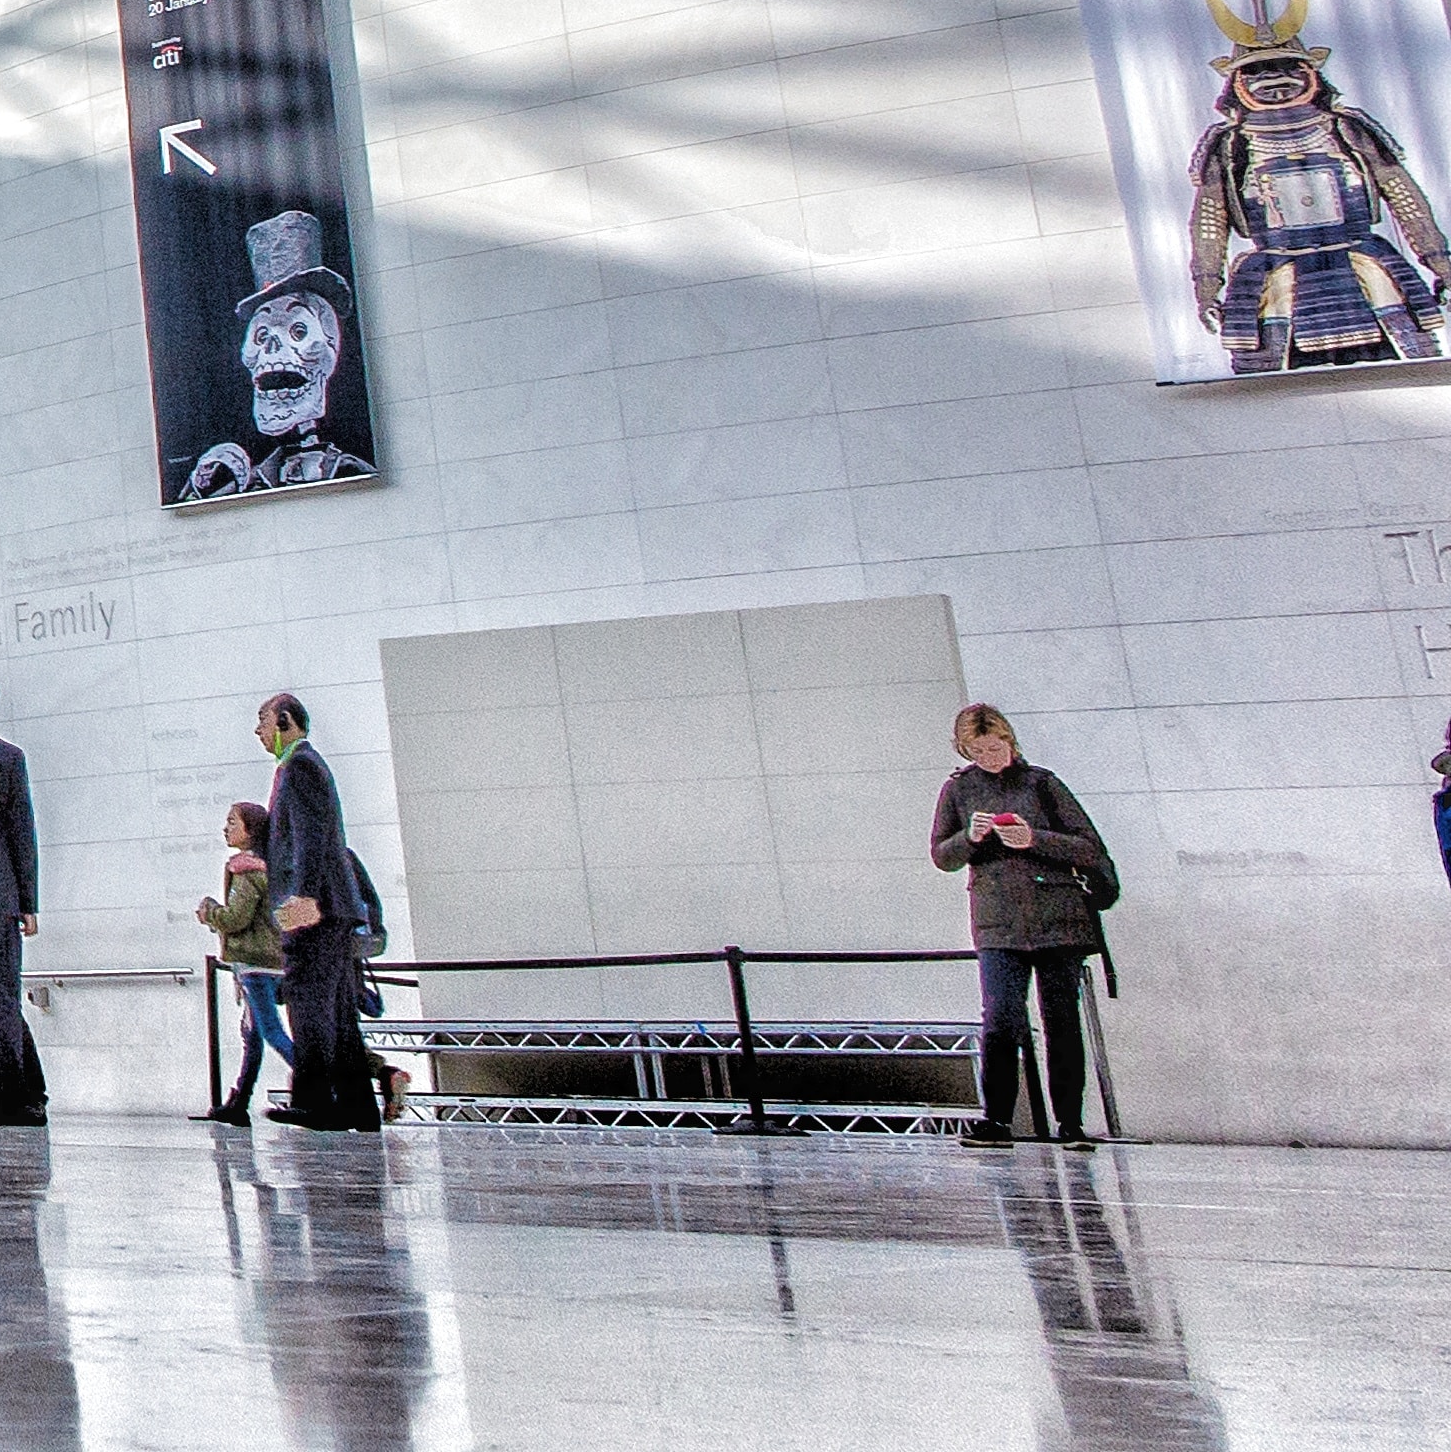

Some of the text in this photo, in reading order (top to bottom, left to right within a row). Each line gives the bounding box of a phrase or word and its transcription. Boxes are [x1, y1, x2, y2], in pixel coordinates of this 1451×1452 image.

[148, 2, 163, 17] 20
[153, 49, 180, 69] citi
[14, 591, 116, 641] Family
